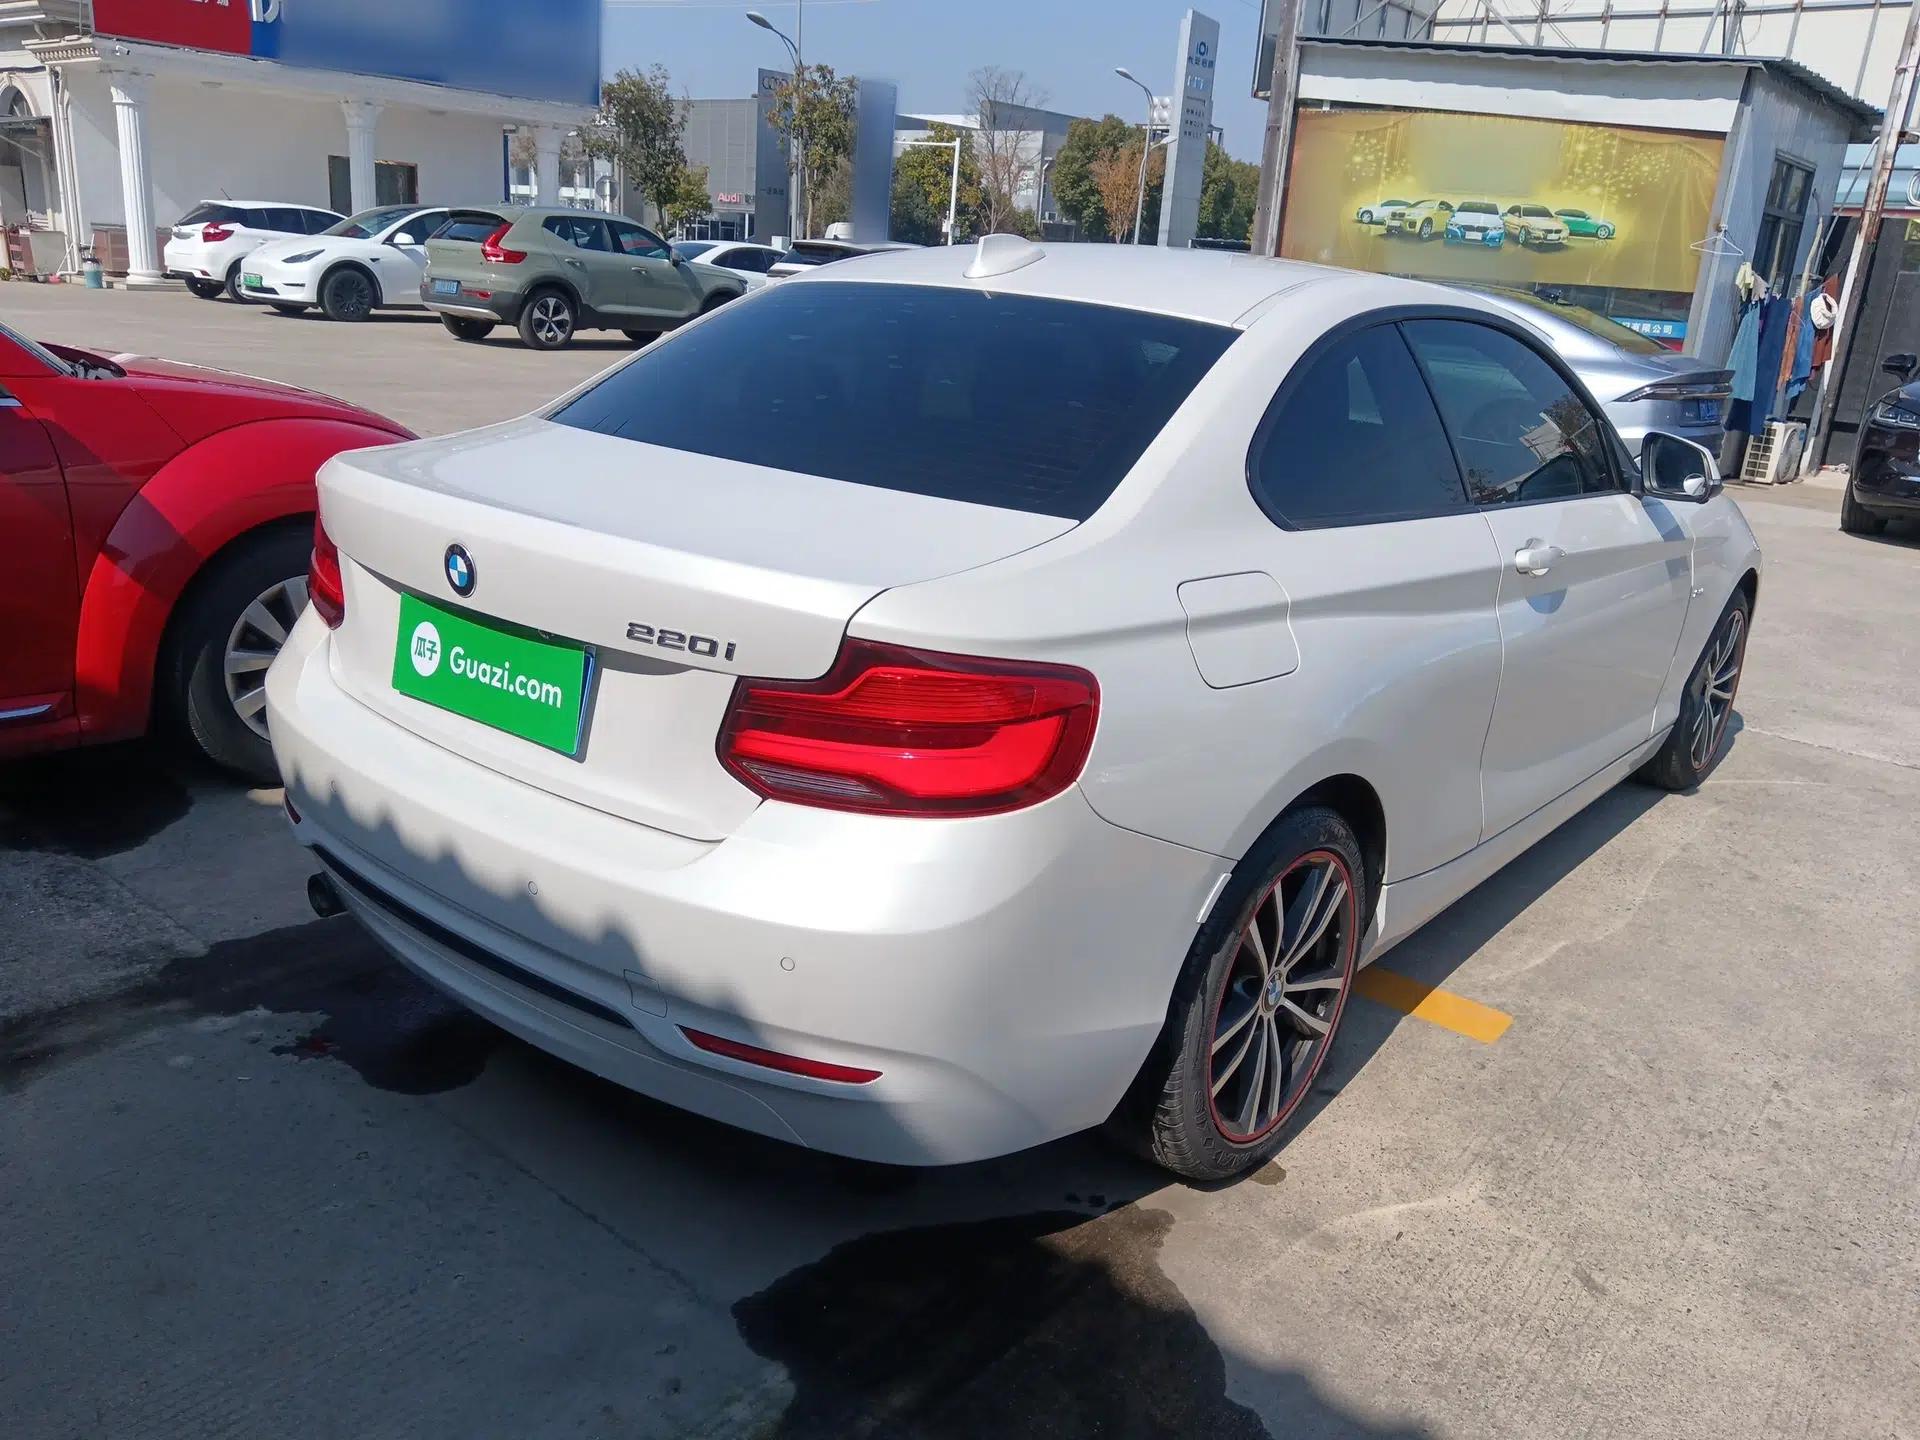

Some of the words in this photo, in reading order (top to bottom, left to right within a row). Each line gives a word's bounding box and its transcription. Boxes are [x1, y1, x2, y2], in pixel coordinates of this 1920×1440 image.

[718, 192, 740, 203] Audi
[414, 636, 438, 662] 瓜子
[626, 621, 736, 661] 220i
[449, 645, 562, 709] Guazi.com
